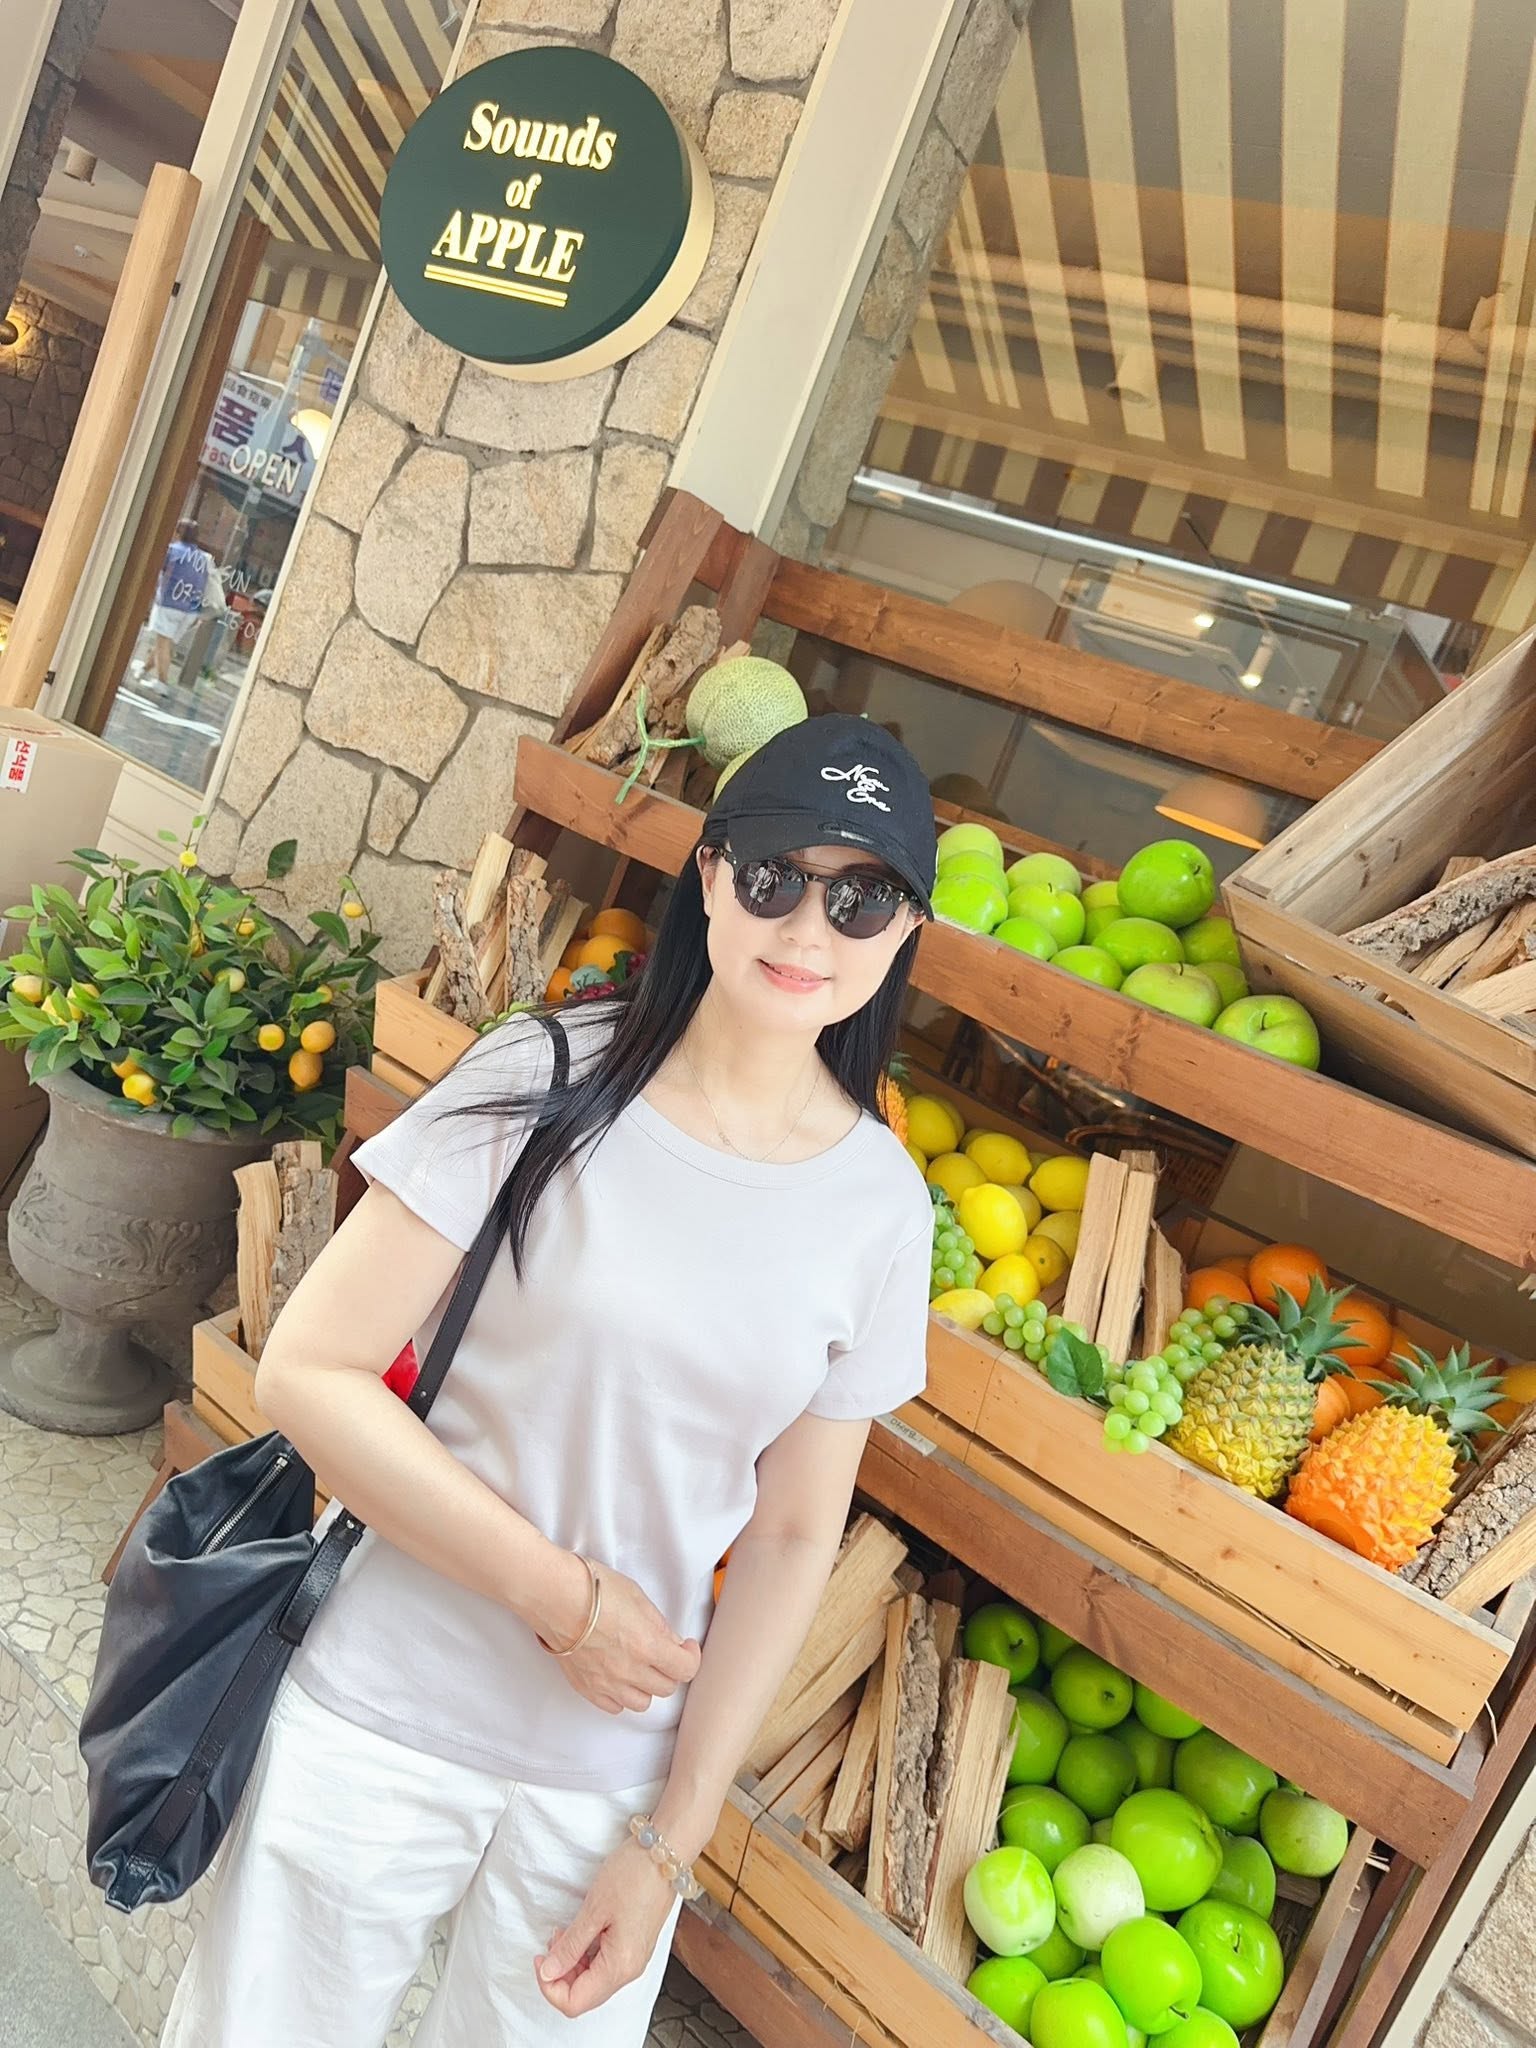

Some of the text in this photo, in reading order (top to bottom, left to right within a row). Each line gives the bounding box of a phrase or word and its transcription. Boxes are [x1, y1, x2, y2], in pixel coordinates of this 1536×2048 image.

[463, 101, 618, 171] Sounds
[505, 173, 542, 210] of
[431, 209, 584, 283] APPLE
[229, 444, 302, 494] OPEN
[221, 565, 251, 593] SUN
